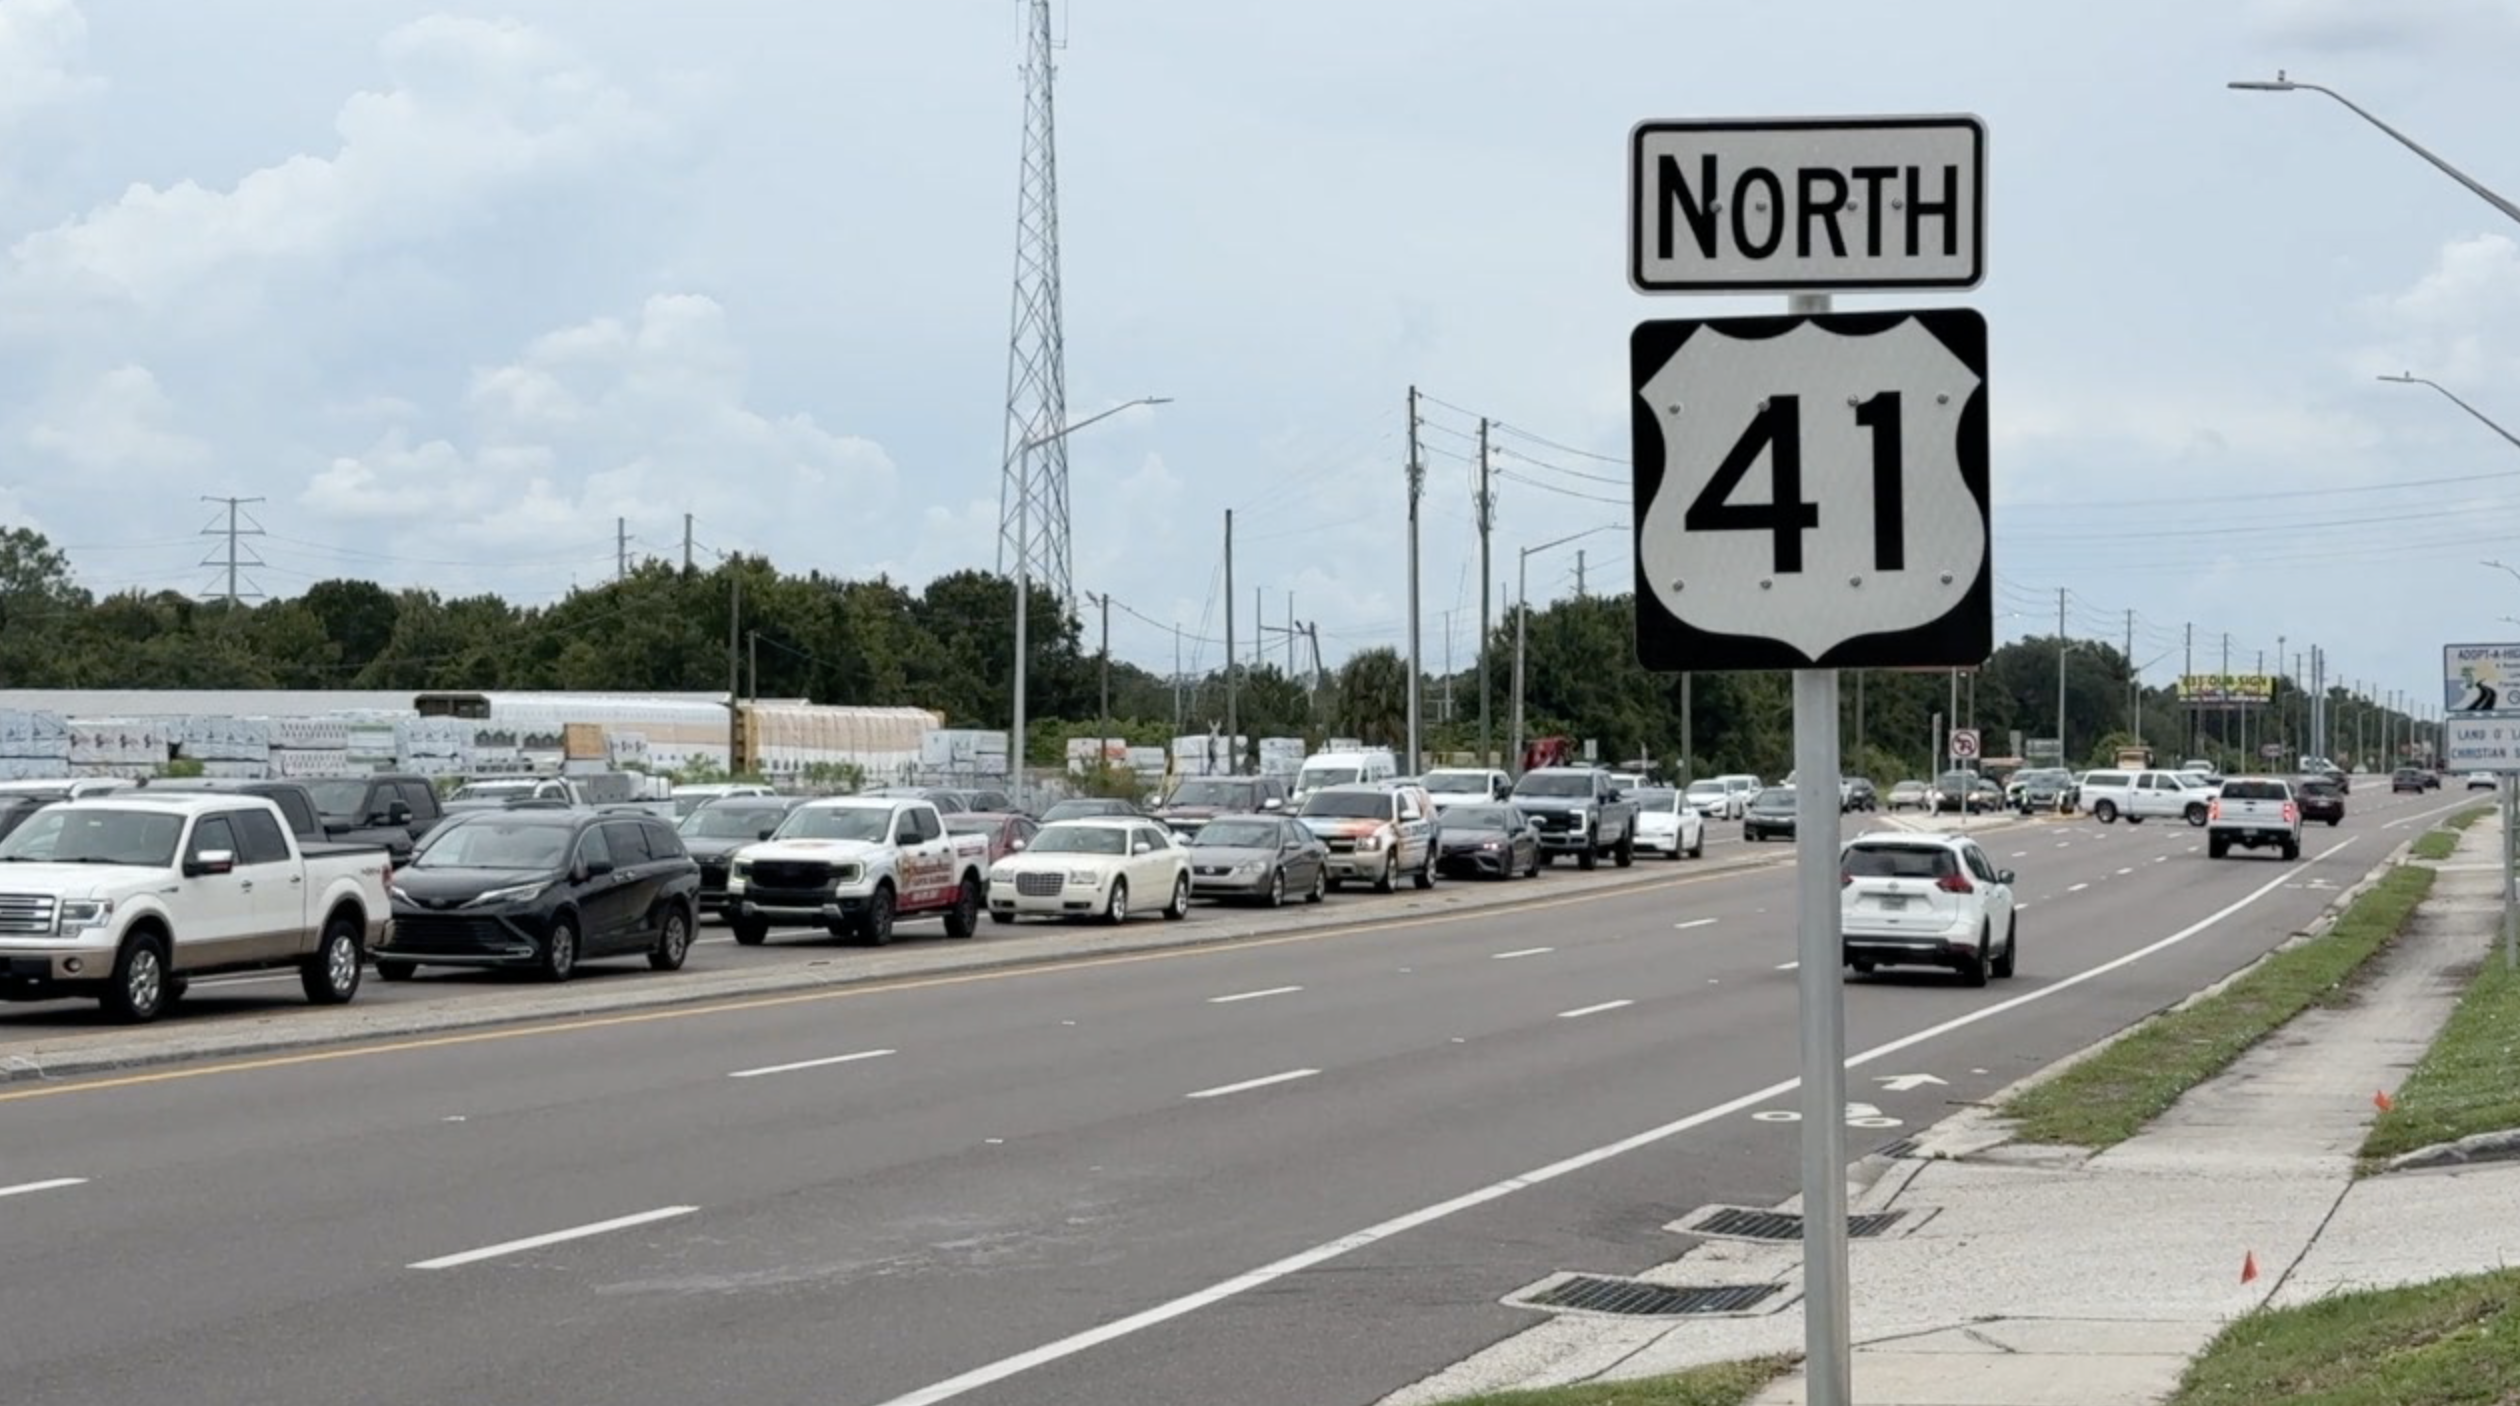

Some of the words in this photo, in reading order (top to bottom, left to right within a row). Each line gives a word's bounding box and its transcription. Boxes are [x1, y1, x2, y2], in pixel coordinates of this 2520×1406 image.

[1657, 153, 1959, 260] NORTH
[1684, 389, 1906, 574] 41
[2451, 747, 2507, 759] CHRISTIAN
[2457, 729, 2486, 741] LAND
